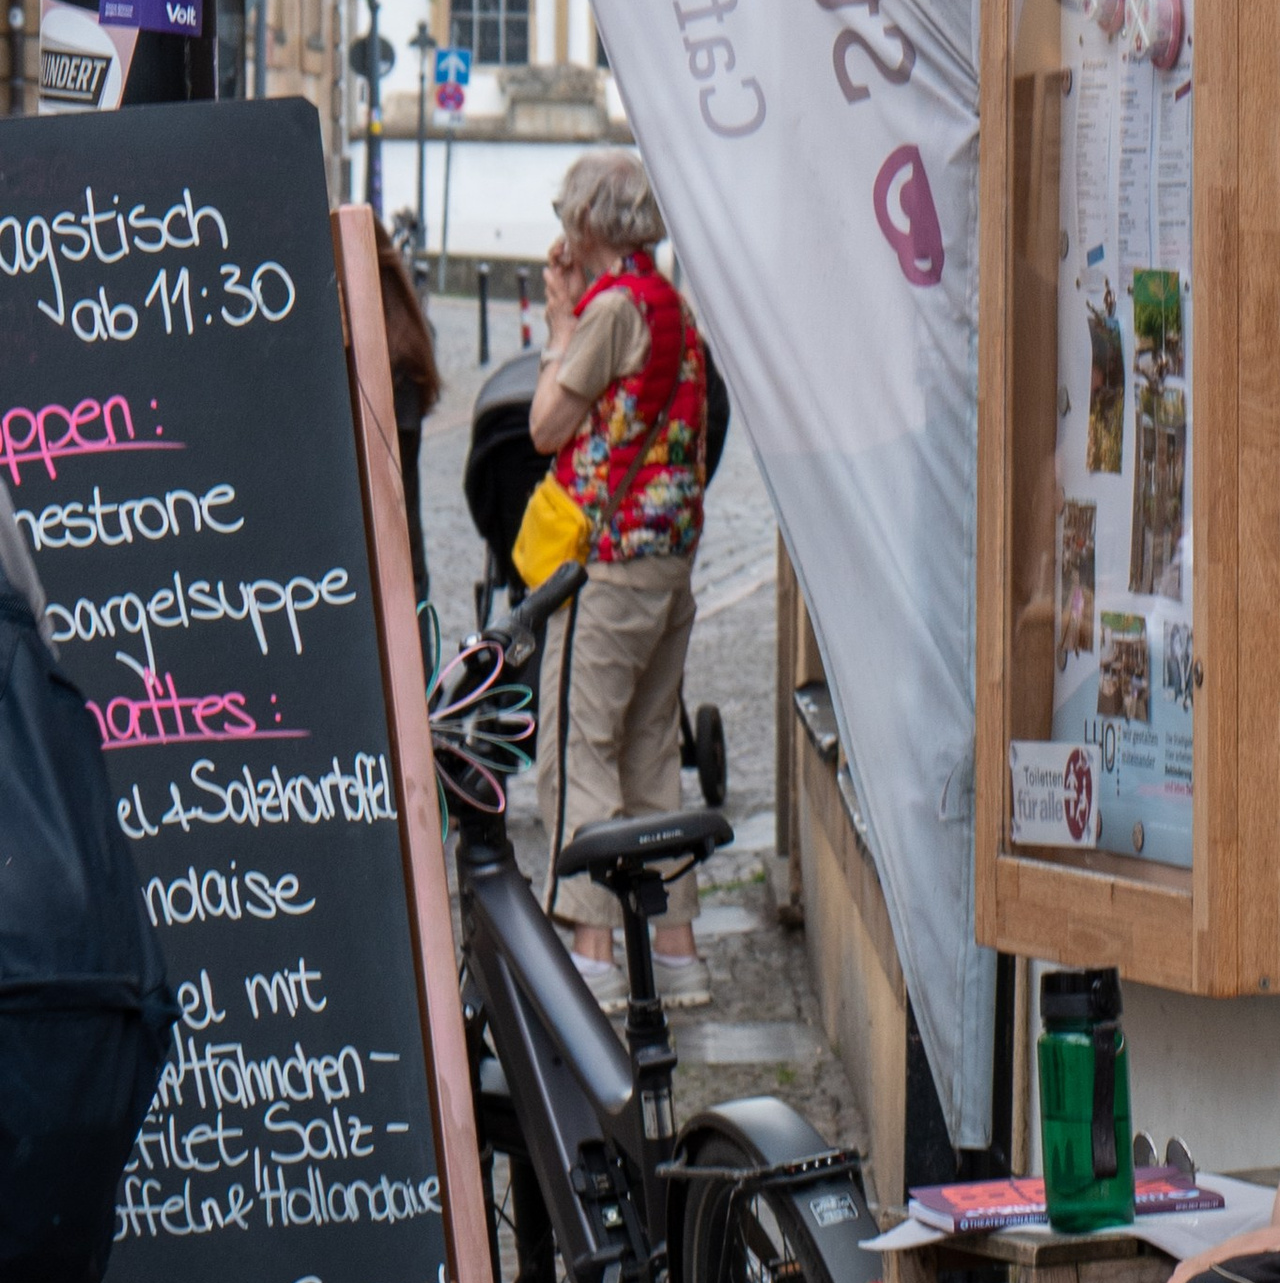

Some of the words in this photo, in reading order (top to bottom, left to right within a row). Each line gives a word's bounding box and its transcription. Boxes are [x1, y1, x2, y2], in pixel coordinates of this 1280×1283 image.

[166, 2, 197, 26] Volt
[71, 286, 138, 344] ab
[145, 261, 296, 335] 11:30
[1017, 790, 1038, 822] für
[1039, 791, 1063, 822] alle
[1023, 765, 1064, 788] Toiletten
[246, 958, 327, 1018] mit
[124, 1111, 262, 1193] filet,
[257, 1165, 443, 1227] Hollandaise
